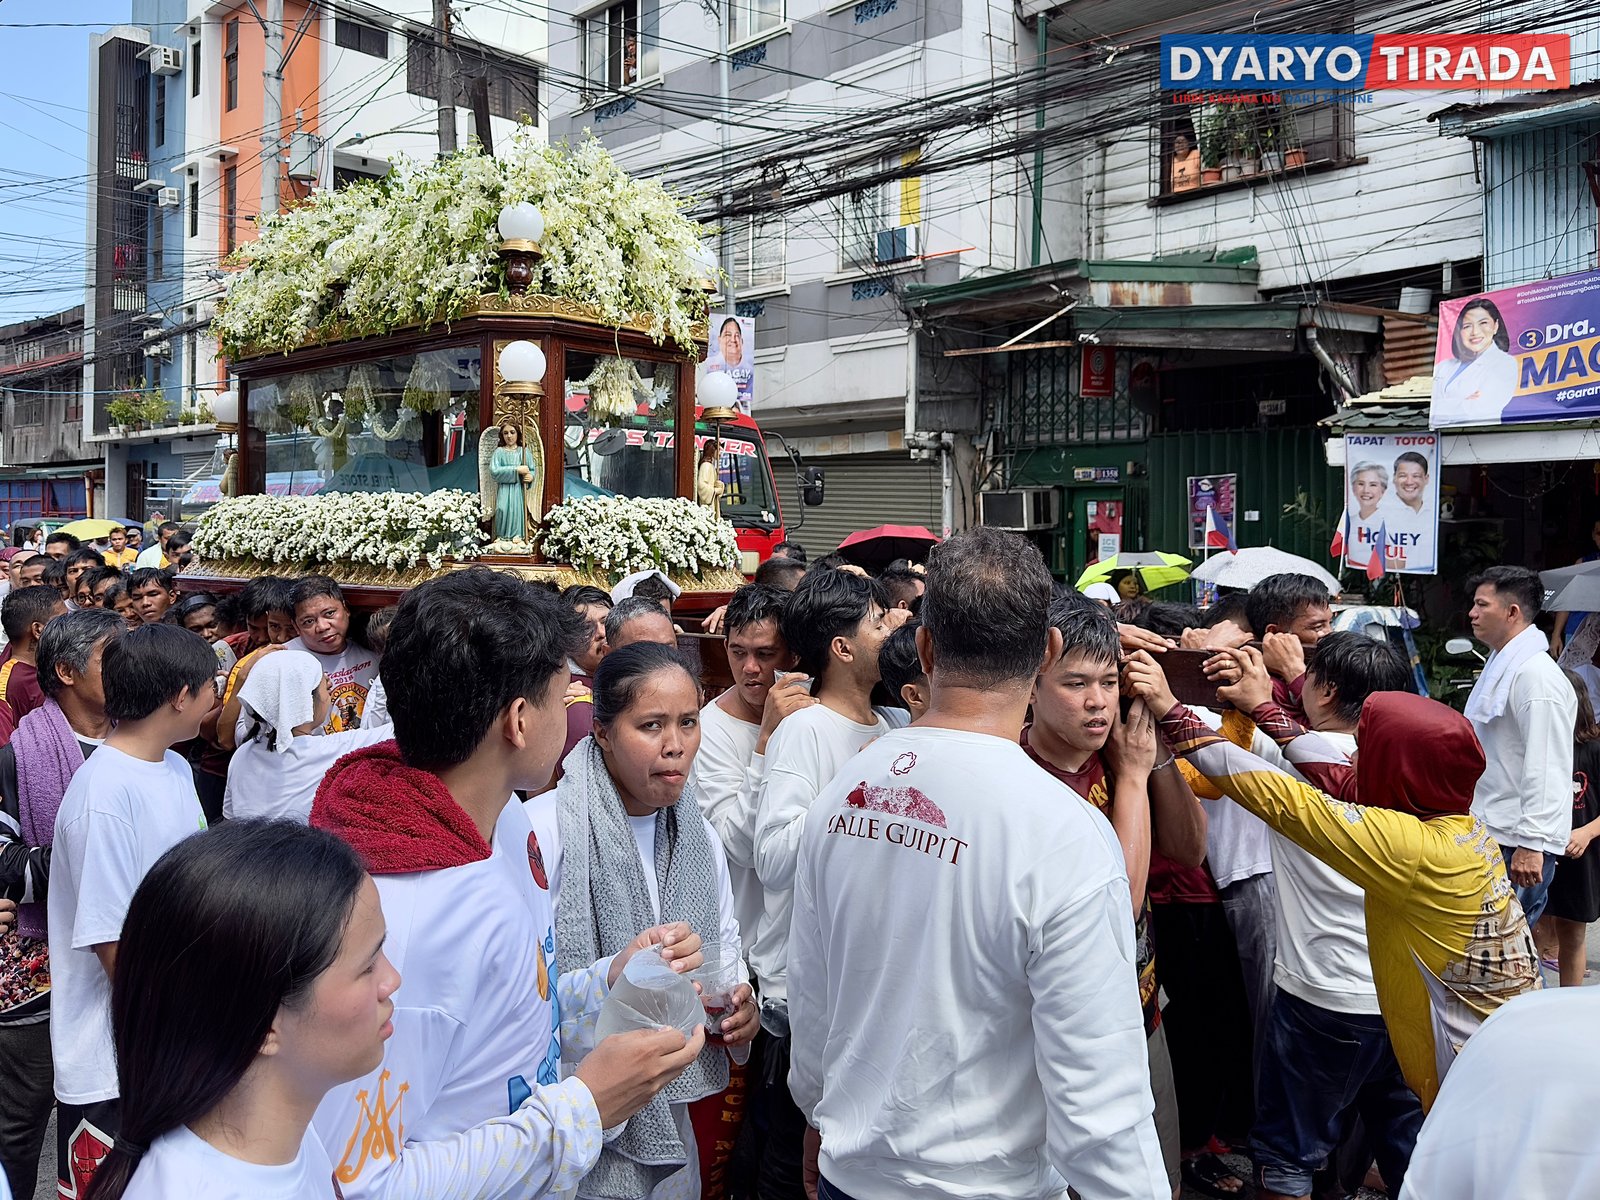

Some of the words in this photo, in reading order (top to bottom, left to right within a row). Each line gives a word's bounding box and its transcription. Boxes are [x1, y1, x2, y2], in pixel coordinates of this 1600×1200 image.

[1525, 332, 1537, 347] 3
[1545, 319, 1596, 344] Dra.
[652, 431, 758, 457] TNER
[1347, 436, 1385, 446] TAPAT
[1395, 436, 1436, 446] TOTOO
[885, 822, 969, 866] GUIPIT
